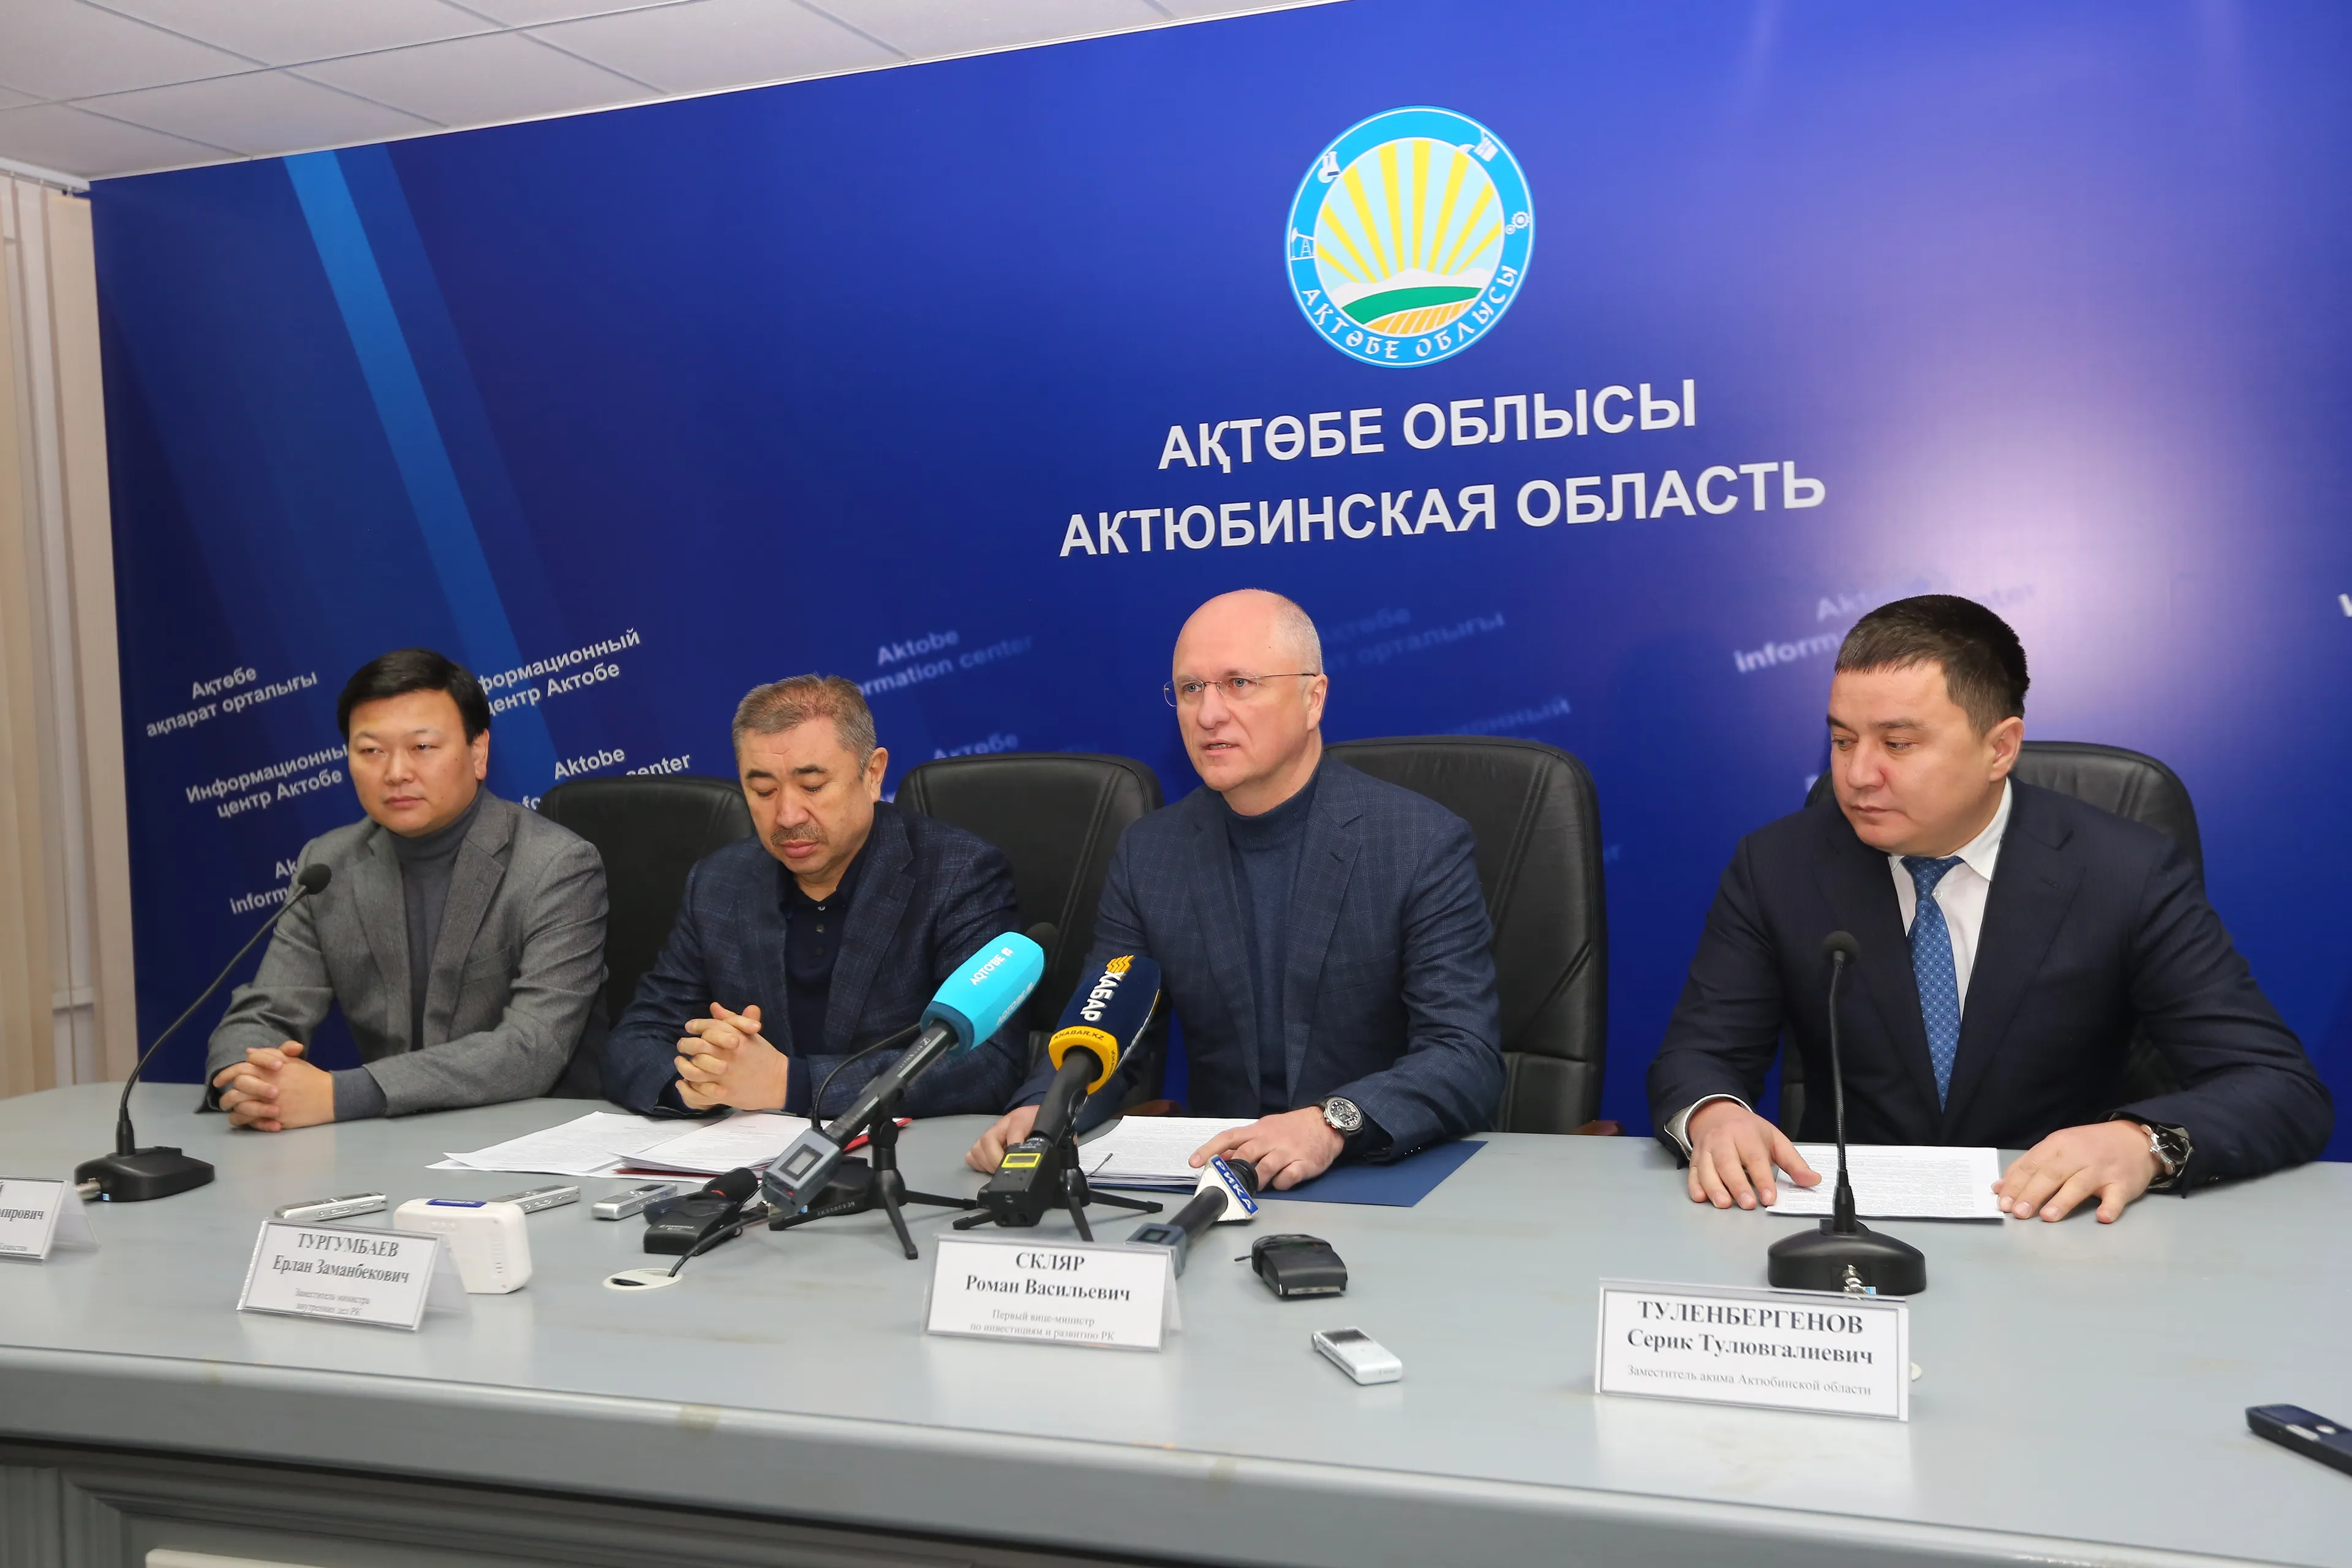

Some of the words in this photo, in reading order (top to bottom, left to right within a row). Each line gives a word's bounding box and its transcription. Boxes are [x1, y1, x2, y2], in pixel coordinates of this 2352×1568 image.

[1415, 265, 1517, 356] ОБЛЫСЫ
[1158, 407, 1384, 473] АҚТӨБЕ
[1403, 379, 1695, 452] ОБЛЫСЫ
[1060, 484, 1496, 557] АКТЮБИНСКАЯ
[1516, 459, 1826, 529] ОБЛАСТЬ
[478, 628, 641, 695] формационный
[877, 630, 959, 666] Aktobe
[1733, 634, 1839, 673] inform
[546, 662, 620, 696] Актобе
[858, 656, 953, 698] ormation
[959, 635, 1033, 669] center
[146, 704, 217, 737] ақпарат
[222, 672, 318, 713] орталығы
[186, 744, 348, 803] Информационны
[554, 748, 625, 780] Aktobe
[217, 791, 271, 818] центр
[277, 769, 342, 801] Актобе
[230, 886, 288, 914] inform
[1054, 1030, 1104, 1041] KHABAR.KZ
[296, 1233, 399, 1257] ТУРГУМБАЕВ
[1015, 1251, 1085, 1272] СКЛЯР
[273, 1255, 313, 1274] Ерлан
[315, 1259, 410, 1283] Заманбекович
[965, 1275, 1019, 1294] Роман
[1024, 1279, 1131, 1301] Васильевич
[984, 1324, 1042, 1336] инвестициям
[1054, 1330, 1099, 1340] развитию
[1101, 1331, 1115, 1341] РК
[992, 1309, 1028, 1322] Первый
[1030, 1315, 1095, 1327] вице-министр
[1637, 1300, 1863, 1335] ТУЛЕНБЕРГЕНОВ
[1627, 1329, 1693, 1352] Серик
[1698, 1333, 1873, 1365] Тулювгалиевич
[1627, 1365, 1697, 1381] Заместитель
[1700, 1373, 1734, 1384] акима
[1738, 1374, 1820, 1392] Актюбинской
[1823, 1381, 1871, 1395] области
